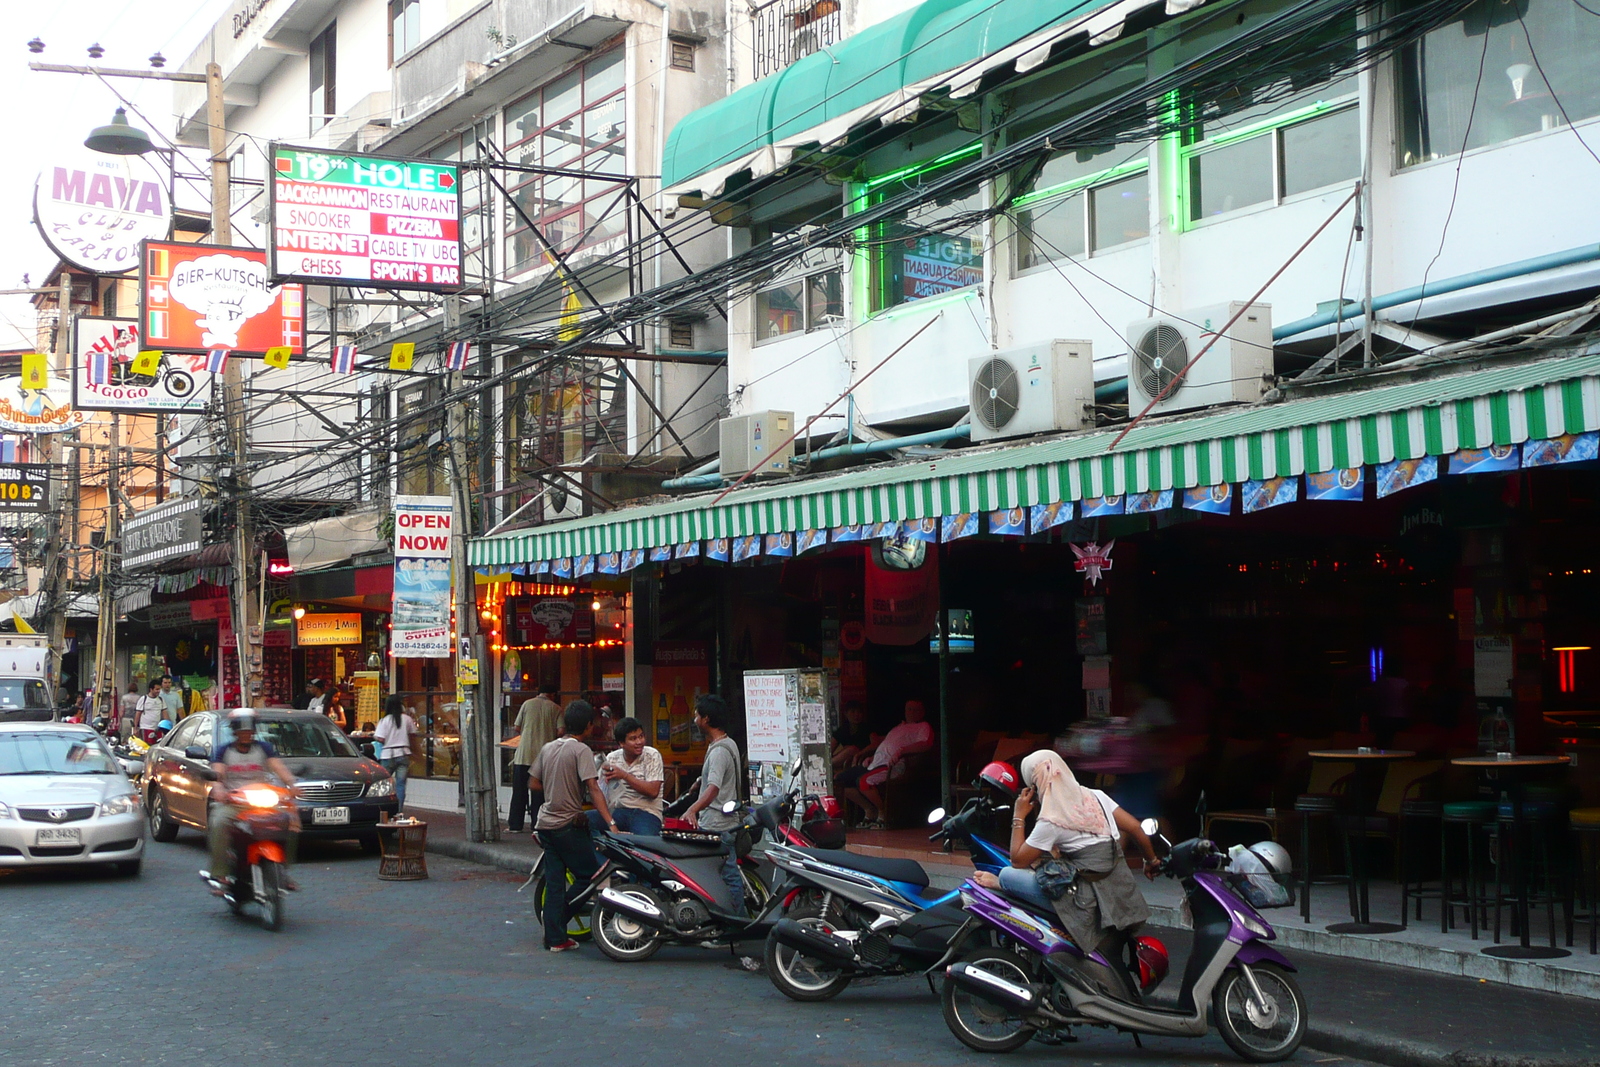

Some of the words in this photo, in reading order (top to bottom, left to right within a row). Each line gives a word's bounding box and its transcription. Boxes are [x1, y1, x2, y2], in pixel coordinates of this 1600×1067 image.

[295, 155, 348, 180] 19th
[353, 162, 435, 190] HOLE
[52, 166, 163, 217] MAYA
[276, 183, 368, 209] BACKGAMMON
[370, 192, 457, 214] RESTAURANT
[290, 210, 351, 229] SNOOKER
[387, 215, 443, 238] PIZZERIA
[52, 222, 157, 262] KARAOK
[277, 228, 369, 253] INTERNET
[371, 239, 408, 257] CABLE
[412, 243, 427, 258] TV
[433, 244, 457, 261] UBC
[301, 257, 342, 275] CHESS
[373, 261, 428, 282] SPORT'S
[432, 266, 459, 284] BAR
[74, 411, 84, 422] 2
[398, 513, 450, 529] OPEN
[1422, 507, 1445, 527] BEA
[399, 535, 448, 551] NOW
[334, 619, 340, 630] 1
[405, 631, 447, 640] OUTLET
